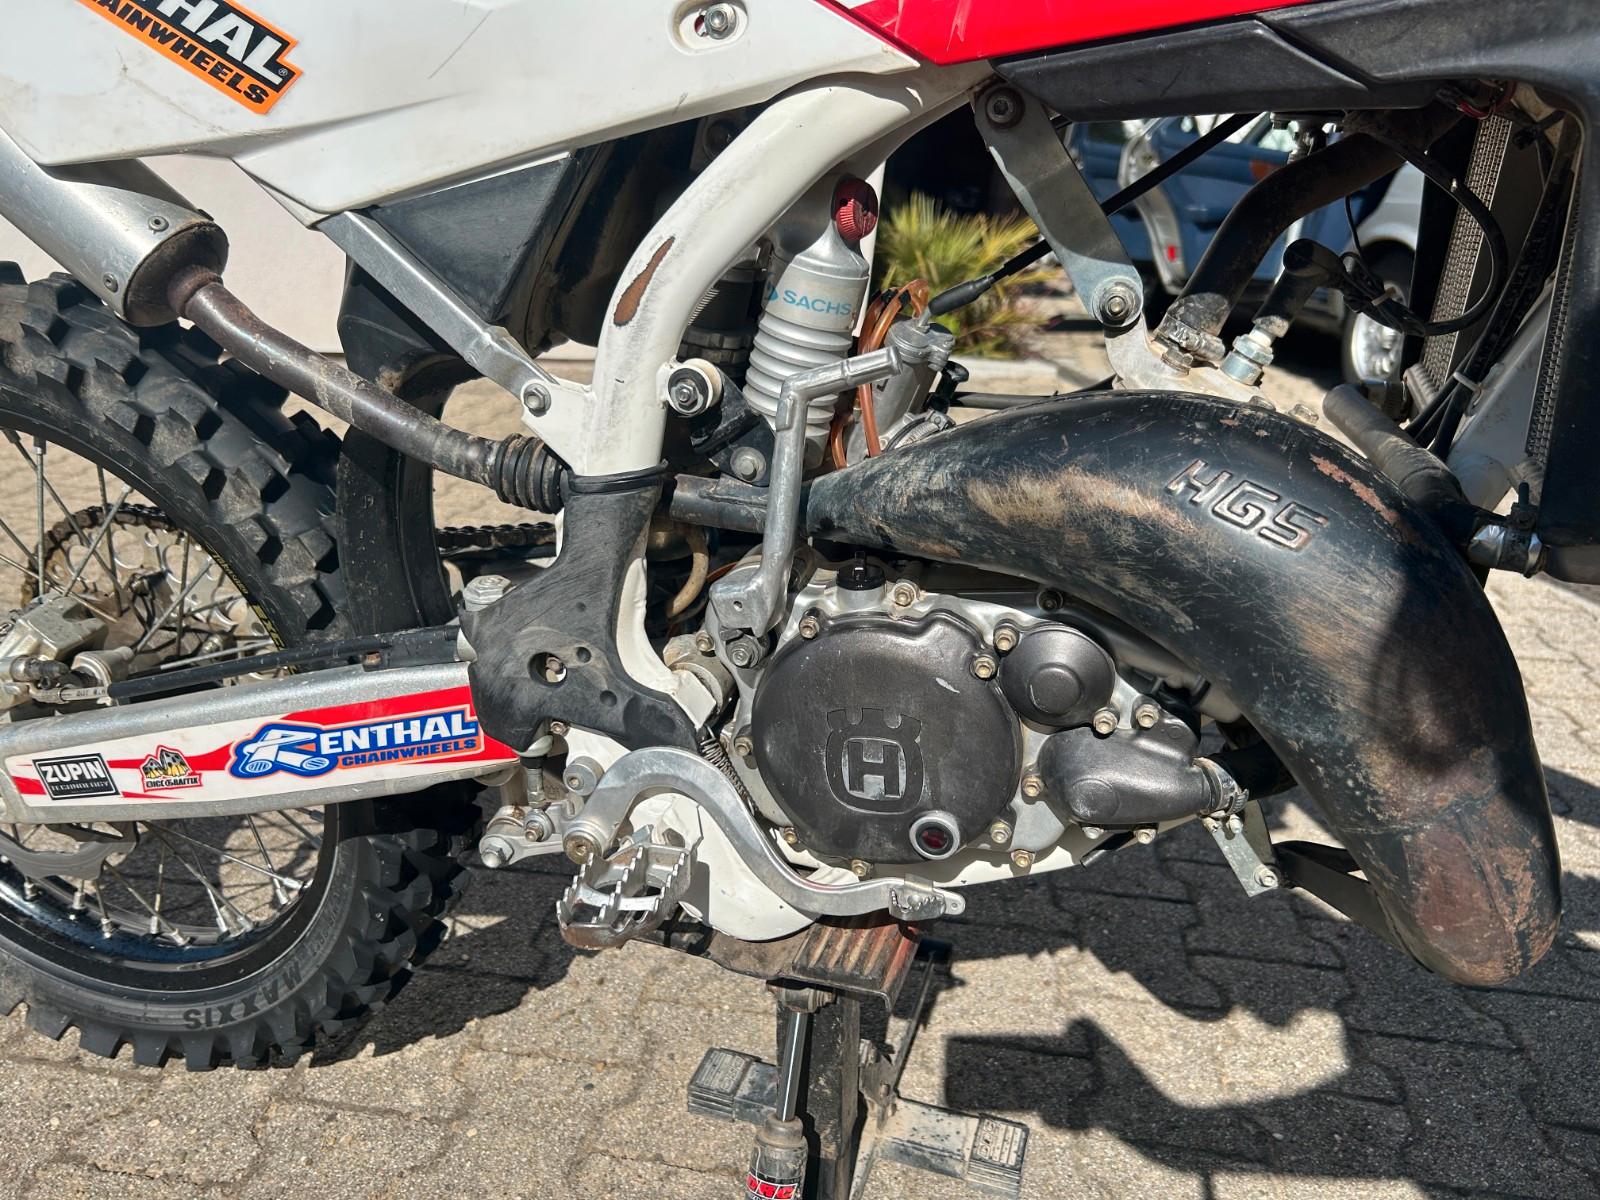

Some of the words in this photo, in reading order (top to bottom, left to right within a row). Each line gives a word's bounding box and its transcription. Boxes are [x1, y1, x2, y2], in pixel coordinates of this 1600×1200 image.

[92, 0, 269, 104] AINWHEELS
[142, 0, 283, 85] HAL
[783, 289, 852, 316] SACHS
[1165, 460, 1329, 552] HGS
[39, 759, 107, 783] ZUPIN
[243, 714, 477, 773] RENTHAL
[341, 738, 477, 767] CHAINWHEELS
[51, 780, 110, 793] TECHNOLOGY
[183, 962, 302, 1030] MAXXIS
